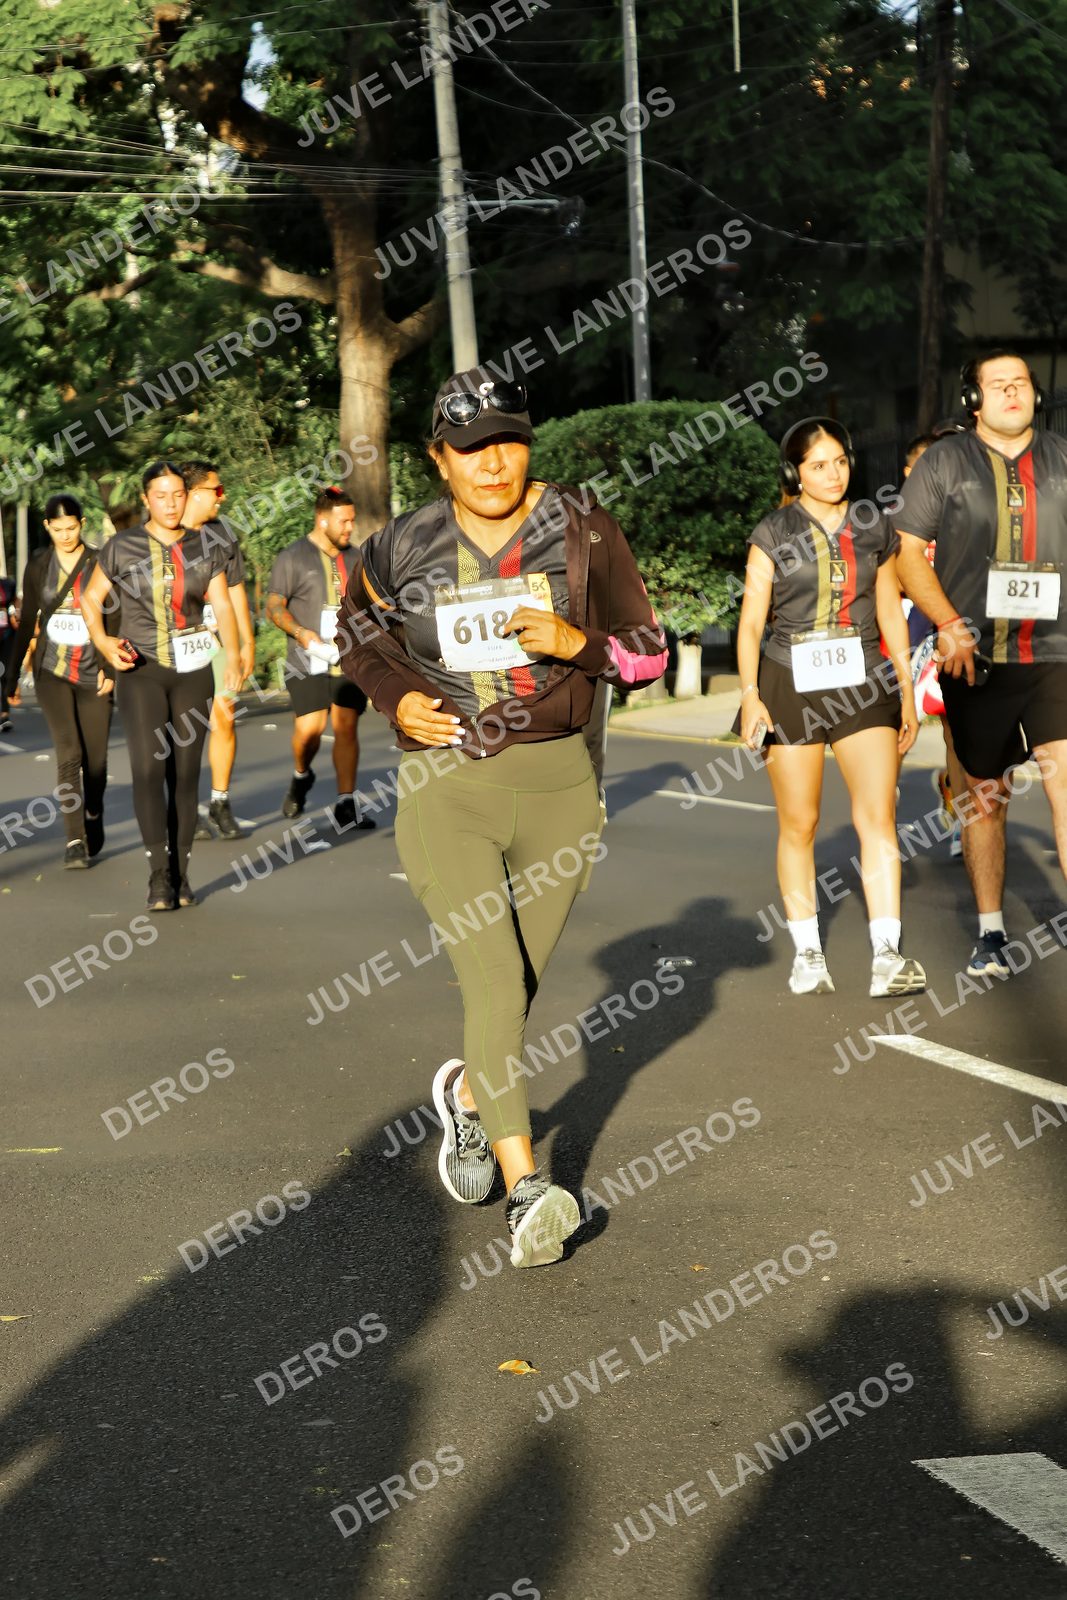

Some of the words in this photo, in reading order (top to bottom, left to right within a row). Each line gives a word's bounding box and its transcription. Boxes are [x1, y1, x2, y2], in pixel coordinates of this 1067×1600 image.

[1007, 580, 1041, 598] 821
[182, 637, 212, 655] 7346
[812, 647, 847, 667] 818
